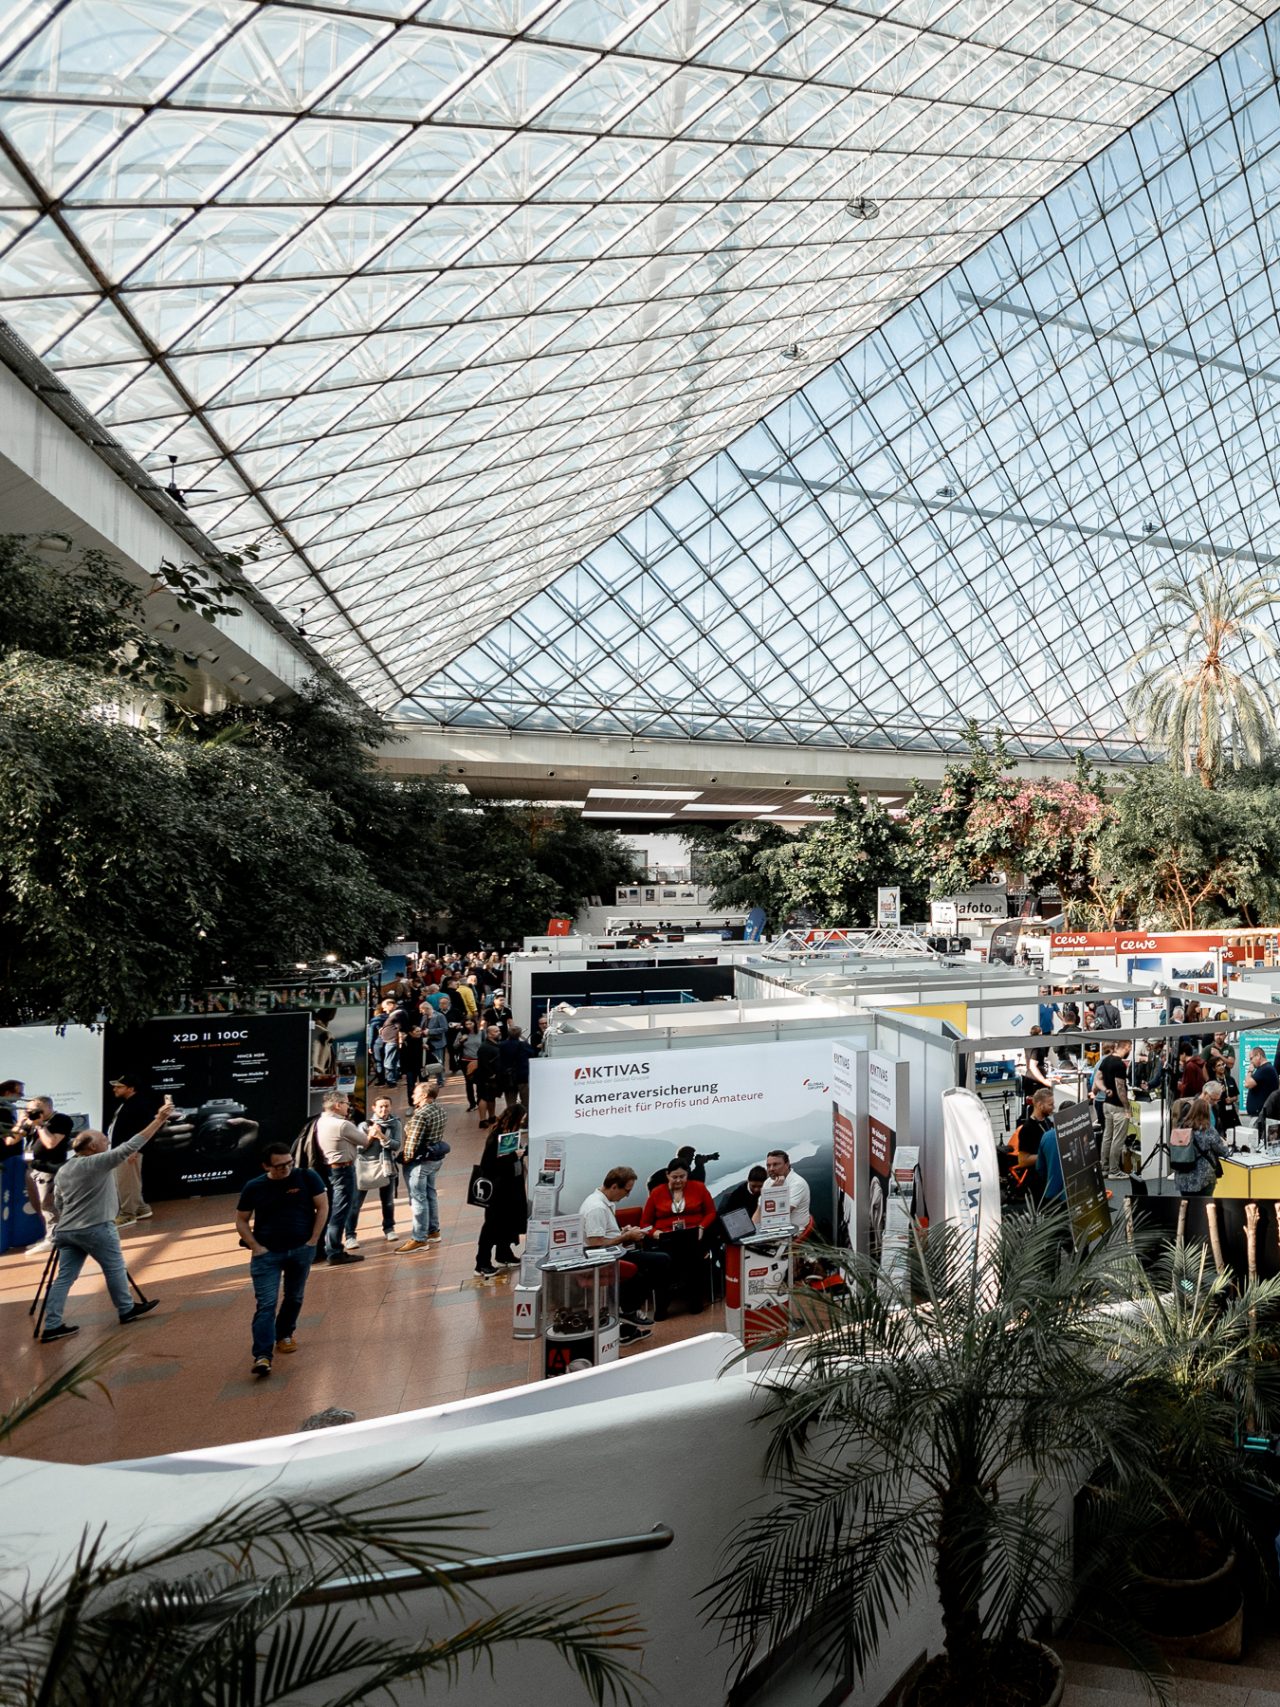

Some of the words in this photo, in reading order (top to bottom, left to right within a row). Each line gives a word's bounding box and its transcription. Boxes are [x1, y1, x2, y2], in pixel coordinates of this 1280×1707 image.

[1054, 934, 1088, 945] cewe
[1120, 939, 1157, 951] cewe
[173, 1033, 198, 1043] X2D
[203, 1032, 211, 1040] II
[217, 1030, 249, 1040] 100C
[574, 1062, 650, 1080] AKTIVAS
[574, 1082, 718, 1105] Kameraversicherung
[574, 1104, 632, 1119] Sicherheit
[636, 1101, 652, 1113] für
[654, 1098, 687, 1110] Profis
[689, 1096, 709, 1107] und
[711, 1090, 764, 1105] Amateure
[181, 1169, 234, 1180] HASSELBLAD
